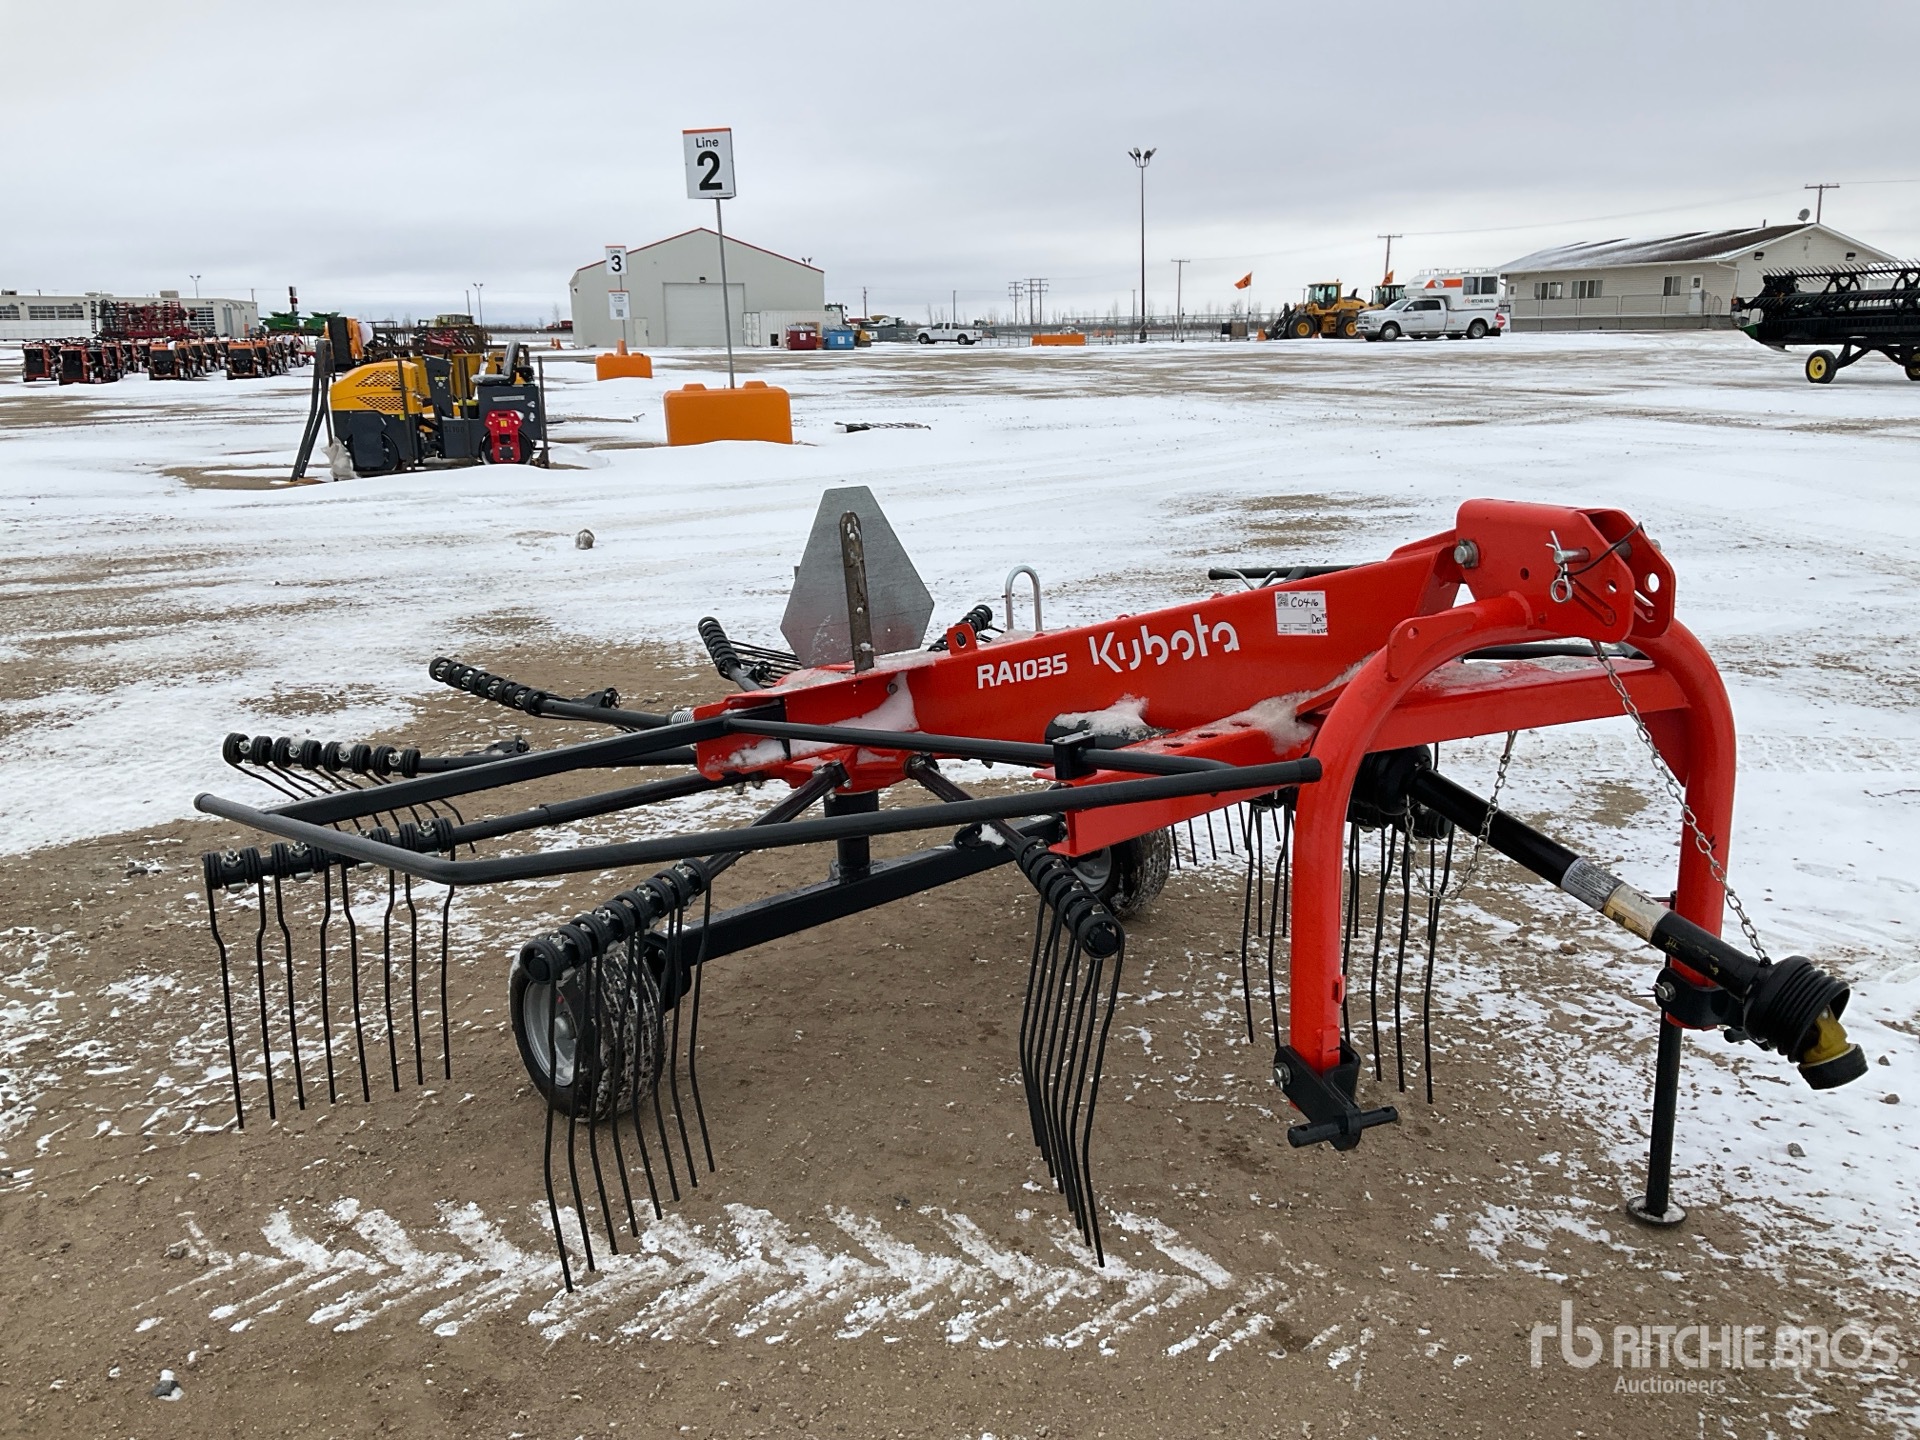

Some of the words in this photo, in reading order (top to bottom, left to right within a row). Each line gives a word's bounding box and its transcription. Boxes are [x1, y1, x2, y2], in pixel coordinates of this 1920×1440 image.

[695, 136, 719, 149] Line
[696, 150, 723, 191] 2
[611, 254, 622, 273] 3
[1089, 613, 1240, 673] Kubota
[977, 653, 1068, 690] RA1035
